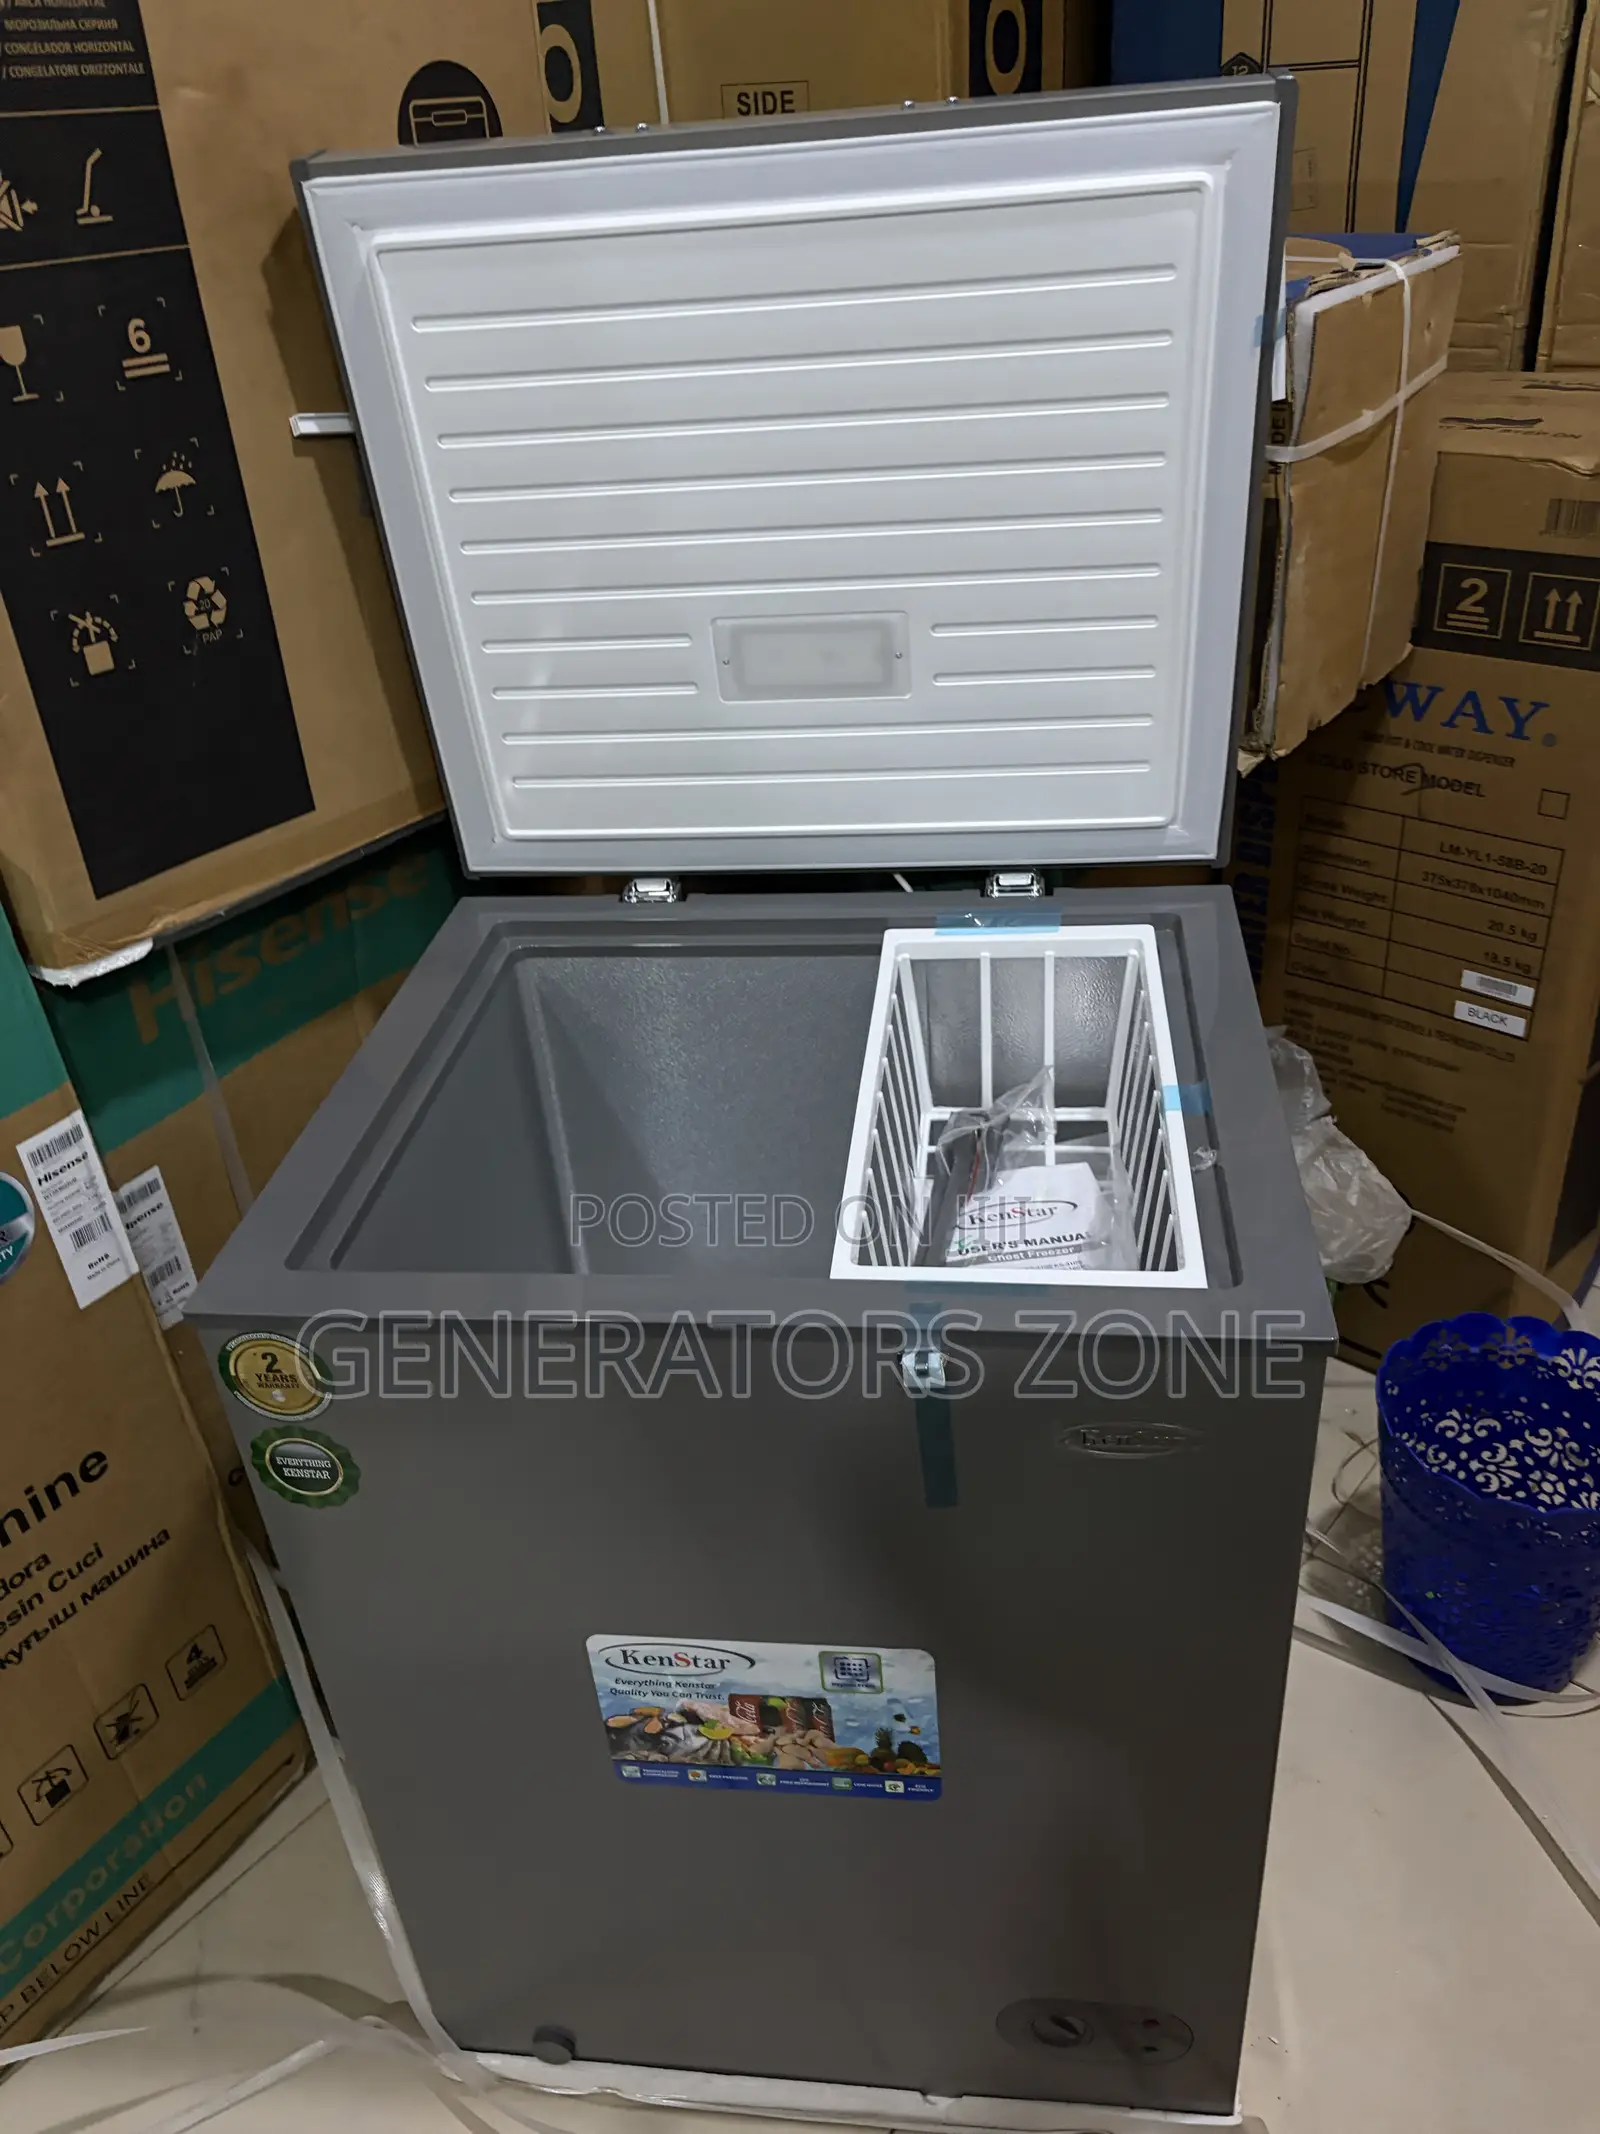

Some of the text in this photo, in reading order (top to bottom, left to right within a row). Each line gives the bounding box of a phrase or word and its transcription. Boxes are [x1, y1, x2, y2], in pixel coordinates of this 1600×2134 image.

[73, 40, 136, 53] HORIZONTAL
[737, 90, 796, 116] SIDE
[128, 318, 151, 353] 6
[1456, 577, 1489, 614] 2
[202, 628, 223, 644] PAP
[1358, 762, 1417, 784] STORE
[1421, 773, 1487, 798] MODEL
[1467, 1006, 1508, 1028] BLACK
[38, 1150, 89, 1187] Hisense
[968, 1203, 1058, 1226] KenStar
[957, 1238, 1020, 1257] USER'S
[1026, 1245, 1076, 1260] Freezer
[261, 1352, 283, 1374] 2
[254, 1372, 298, 1384] YEARS
[275, 1455, 331, 1469] EVERYTHING
[282, 1467, 331, 1481] KENSTAR
[80, 1528, 171, 1606] машина
[620, 1649, 731, 1670] KenStar
[610, 1688, 726, 1701] Quality You Can Trust.
[614, 1678, 716, 1690] Everything Kenstar
